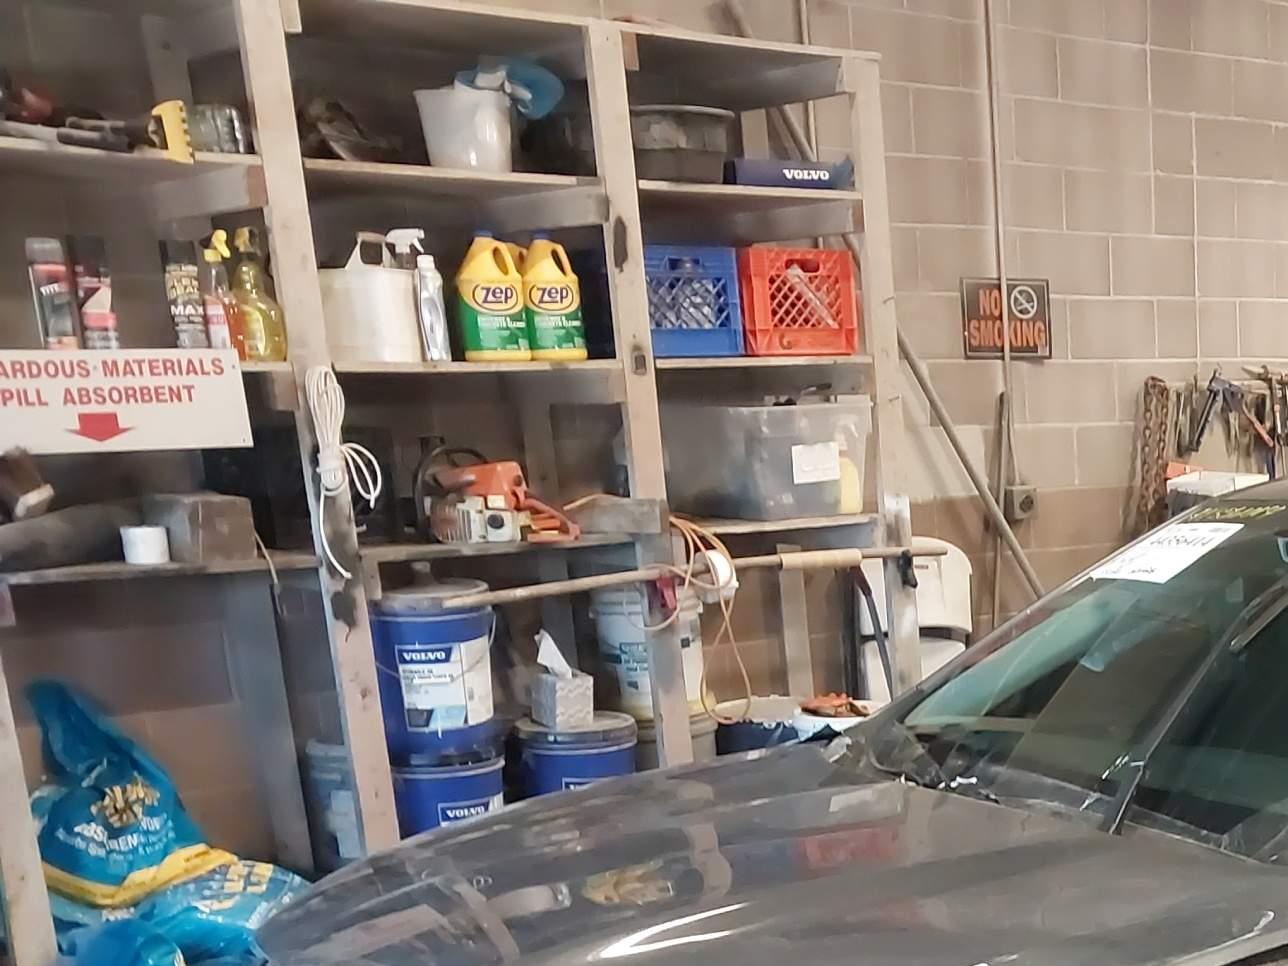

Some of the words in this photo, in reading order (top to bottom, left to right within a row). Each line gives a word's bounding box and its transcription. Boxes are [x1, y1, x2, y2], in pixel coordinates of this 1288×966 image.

[783, 169, 830, 180] VOLVO
[979, 288, 1001, 317] NO
[102, 358, 225, 378] MATERIALS
[63, 385, 196, 406] ABSORBENT
[402, 650, 447, 661] VOLVO
[446, 805, 485, 819] VOLVO
